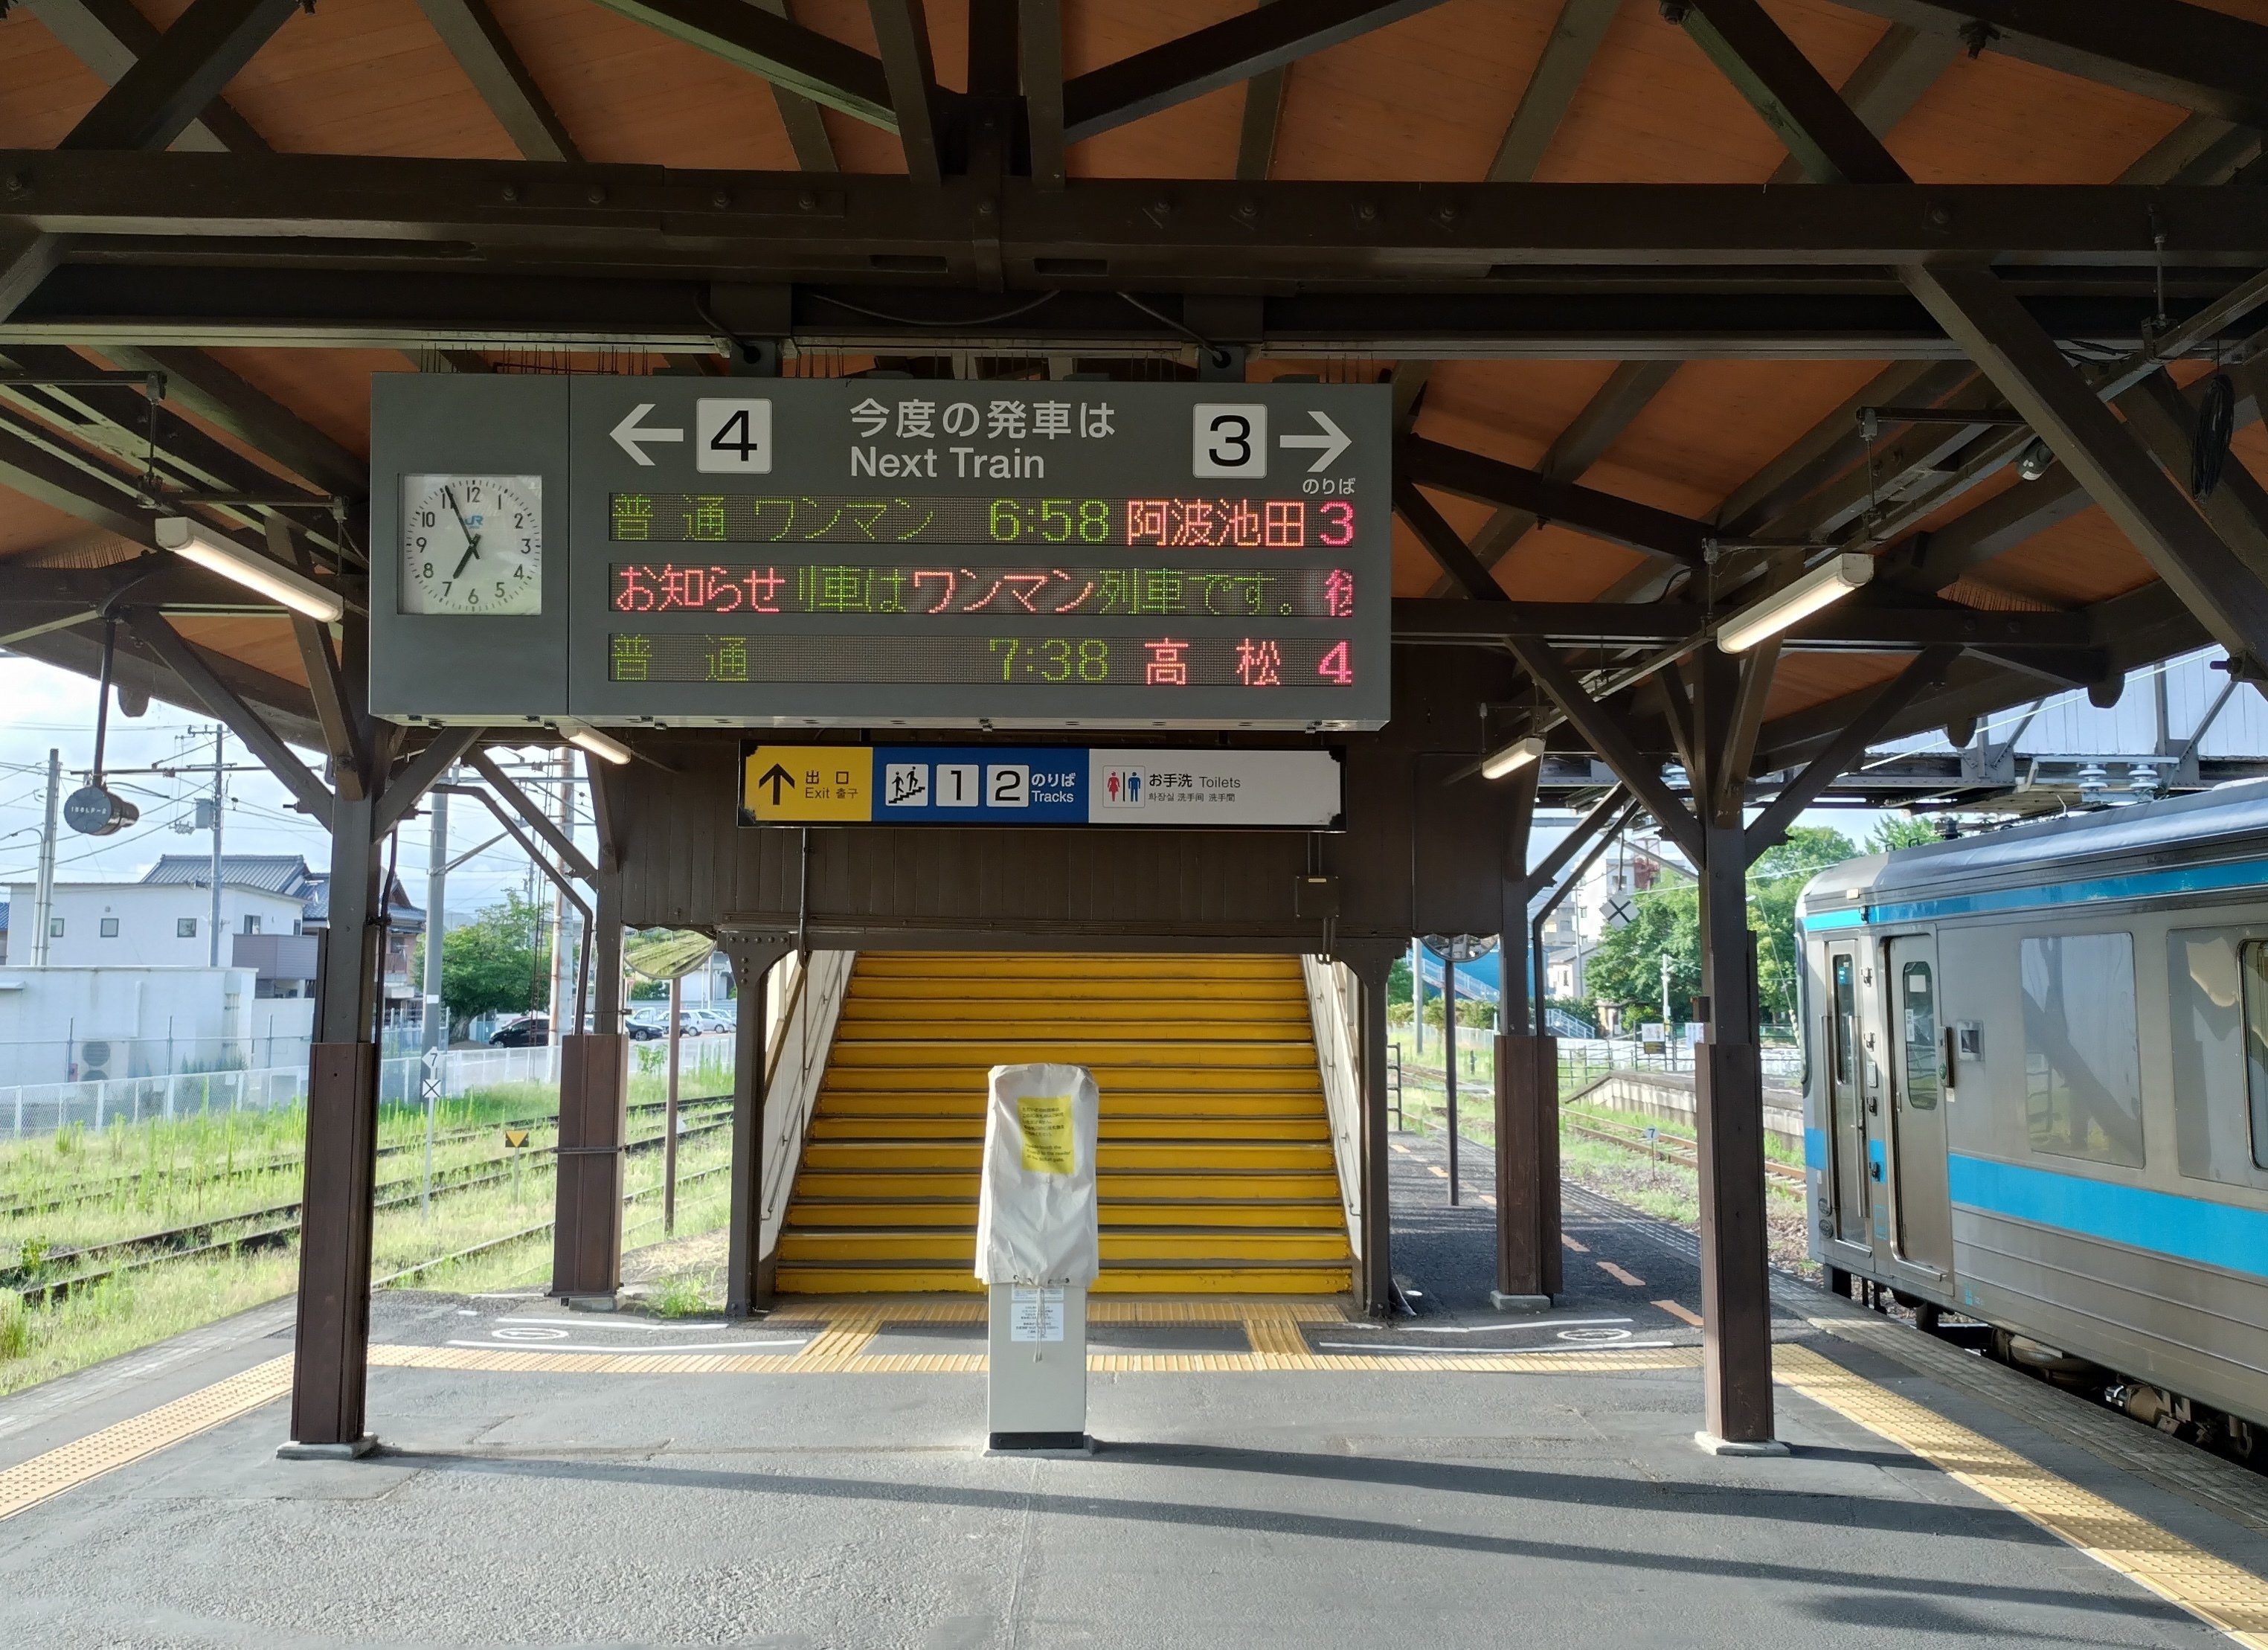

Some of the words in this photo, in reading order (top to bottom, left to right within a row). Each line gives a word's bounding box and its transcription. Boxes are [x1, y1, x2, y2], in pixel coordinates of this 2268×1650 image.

[849, 398, 1115, 440] 今度の発車は
[710, 410, 757, 462] 4
[1208, 414, 1252, 466] 3
[850, 446, 936, 478] Next
[949, 446, 1045, 479] Train
[1302, 476, 1356, 495] のりば
[989, 499, 1110, 542] 6:58
[1127, 498, 1305, 547] 阿波池田
[1319, 501, 1354, 546] 3
[989, 639, 1109, 682] 7:38
[1318, 640, 1352, 684] 4
[951, 770, 962, 801] 1
[995, 770, 1021, 801] 2
[1031, 772, 1077, 787] のりば
[1149, 773, 1192, 789] お手洗
[1199, 776, 1241, 789] Toilets
[805, 787, 831, 800] Exit
[835, 787, 859, 800] 출구
[1031, 790, 1075, 803] Tracks
[1149, 792, 1175, 803] 화장실
[431, 1053, 437, 1066] 7
[1648, 1129, 1655, 1138] 7
